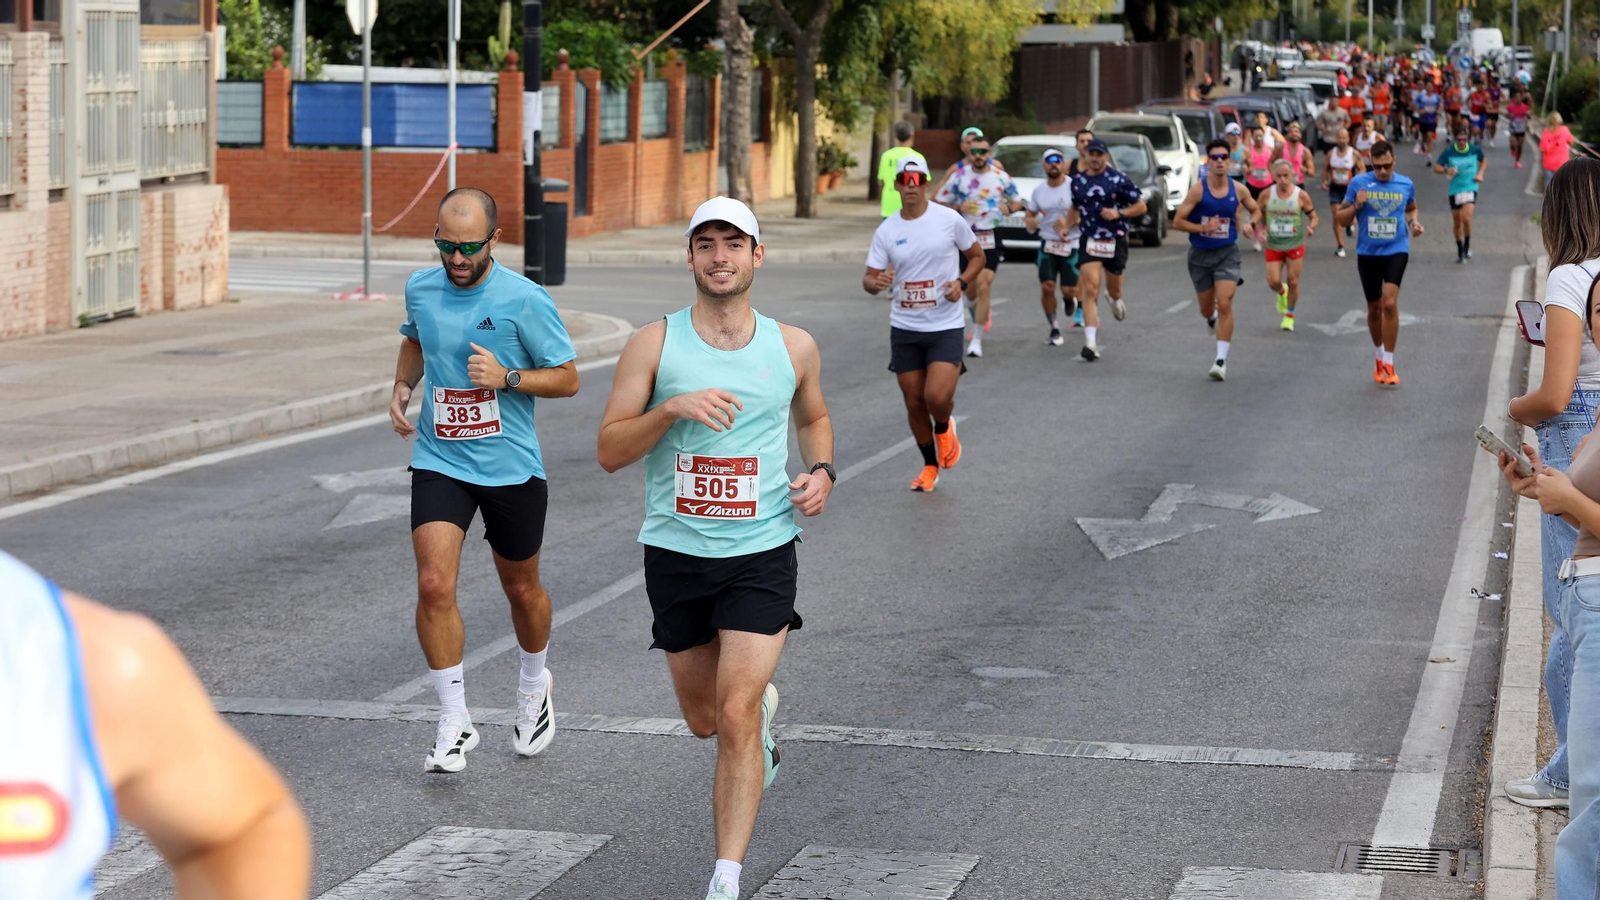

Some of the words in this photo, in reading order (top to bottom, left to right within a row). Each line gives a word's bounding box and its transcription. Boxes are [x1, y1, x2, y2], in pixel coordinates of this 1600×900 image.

[906, 290, 926, 300] 278
[446, 405, 482, 423] 383
[698, 465, 719, 473] XXIX
[694, 476, 738, 499] 505
